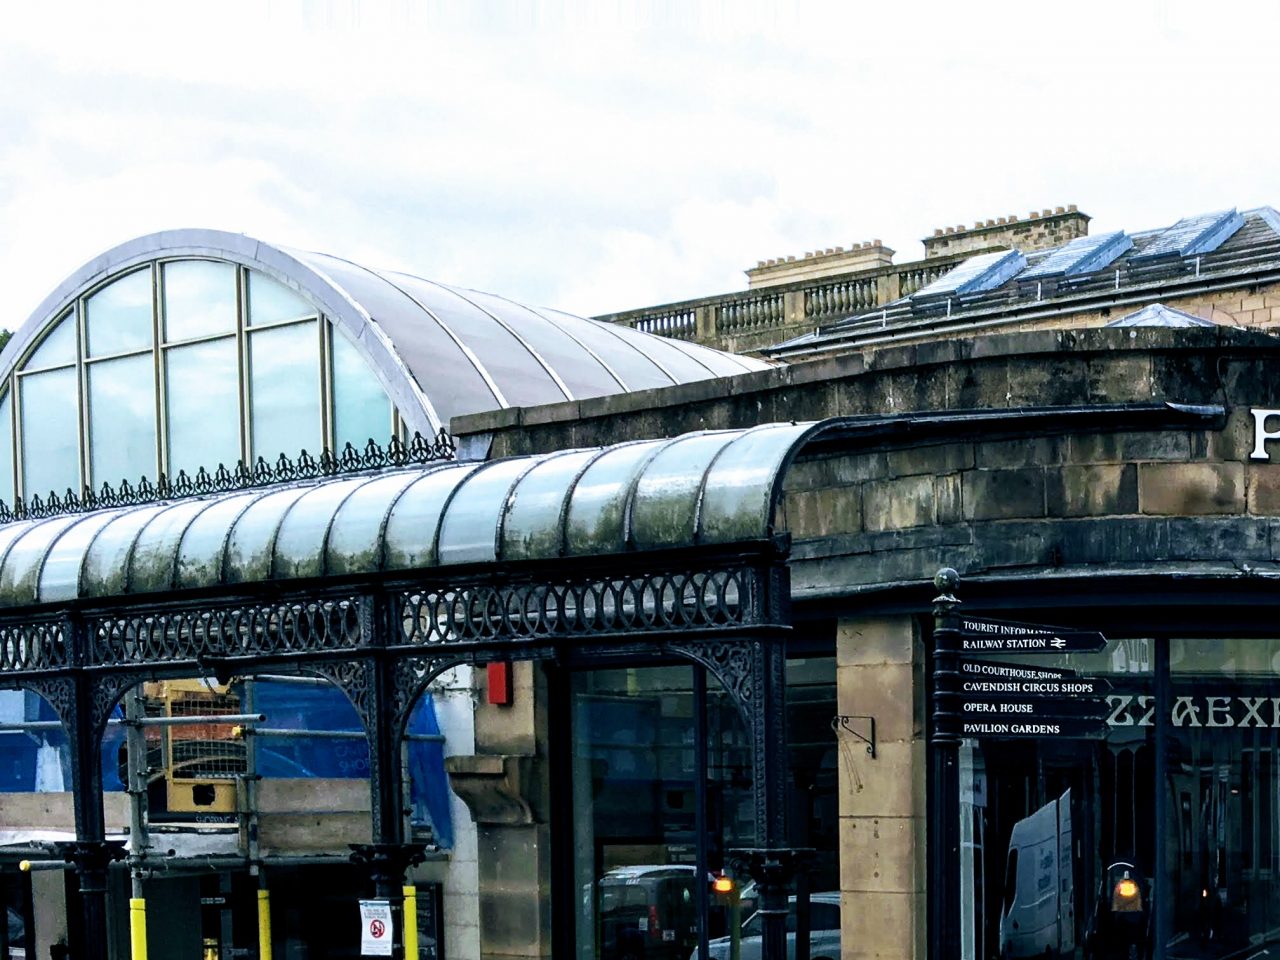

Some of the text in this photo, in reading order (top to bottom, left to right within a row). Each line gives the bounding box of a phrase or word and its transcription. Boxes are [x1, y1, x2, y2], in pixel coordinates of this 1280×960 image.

[963, 621, 999, 633] TOURIST
[963, 639, 1046, 649] RAILWAY STATION
[963, 664, 981, 674] OLD
[982, 666, 1036, 679] COURTHOUSE
[963, 683, 1094, 693] CAVENDISH CIRCUS SHOPS
[963, 703, 1034, 713] OPERA HOUSE
[963, 724, 1060, 734] PAVILION GARDENS
